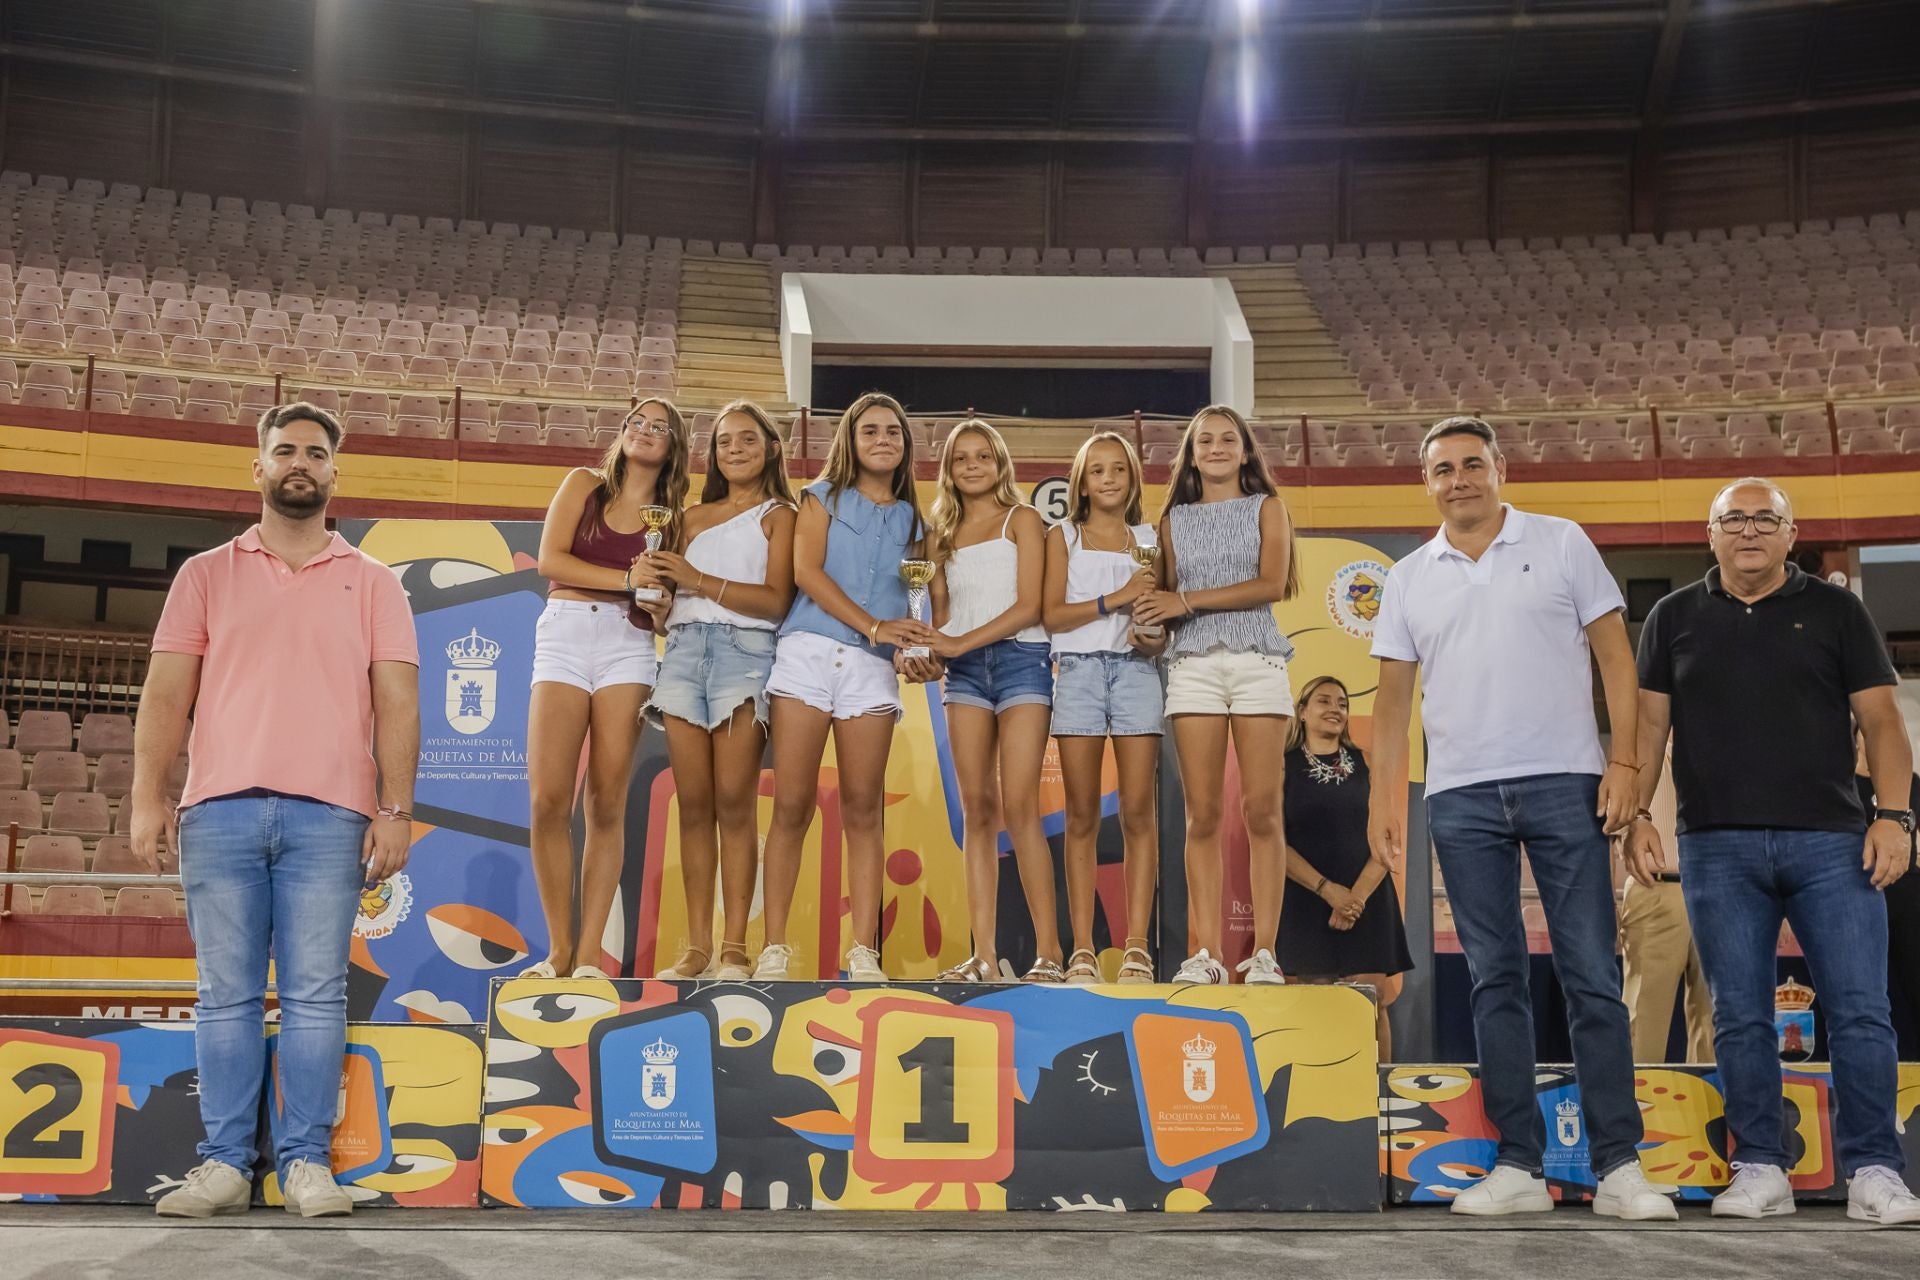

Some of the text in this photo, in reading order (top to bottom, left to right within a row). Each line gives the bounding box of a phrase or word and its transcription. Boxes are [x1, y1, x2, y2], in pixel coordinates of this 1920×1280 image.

[1048, 488, 1069, 520] 5
[426, 738, 513, 748] AYUNTAMIENTO DE
[479, 752, 497, 763] DE
[426, 770, 460, 781] Deportes,
[461, 771, 487, 781] Cultura
[493, 772, 519, 782] Tiempo
[365, 926, 391, 937] VIDA
[897, 1036, 969, 1143] 1
[3, 1063, 84, 1159] 2
[1158, 1111, 1204, 1121] ROQUETAS
[1220, 1112, 1241, 1121] MAR
[614, 1119, 702, 1130] ROQUETAS DE MAR
